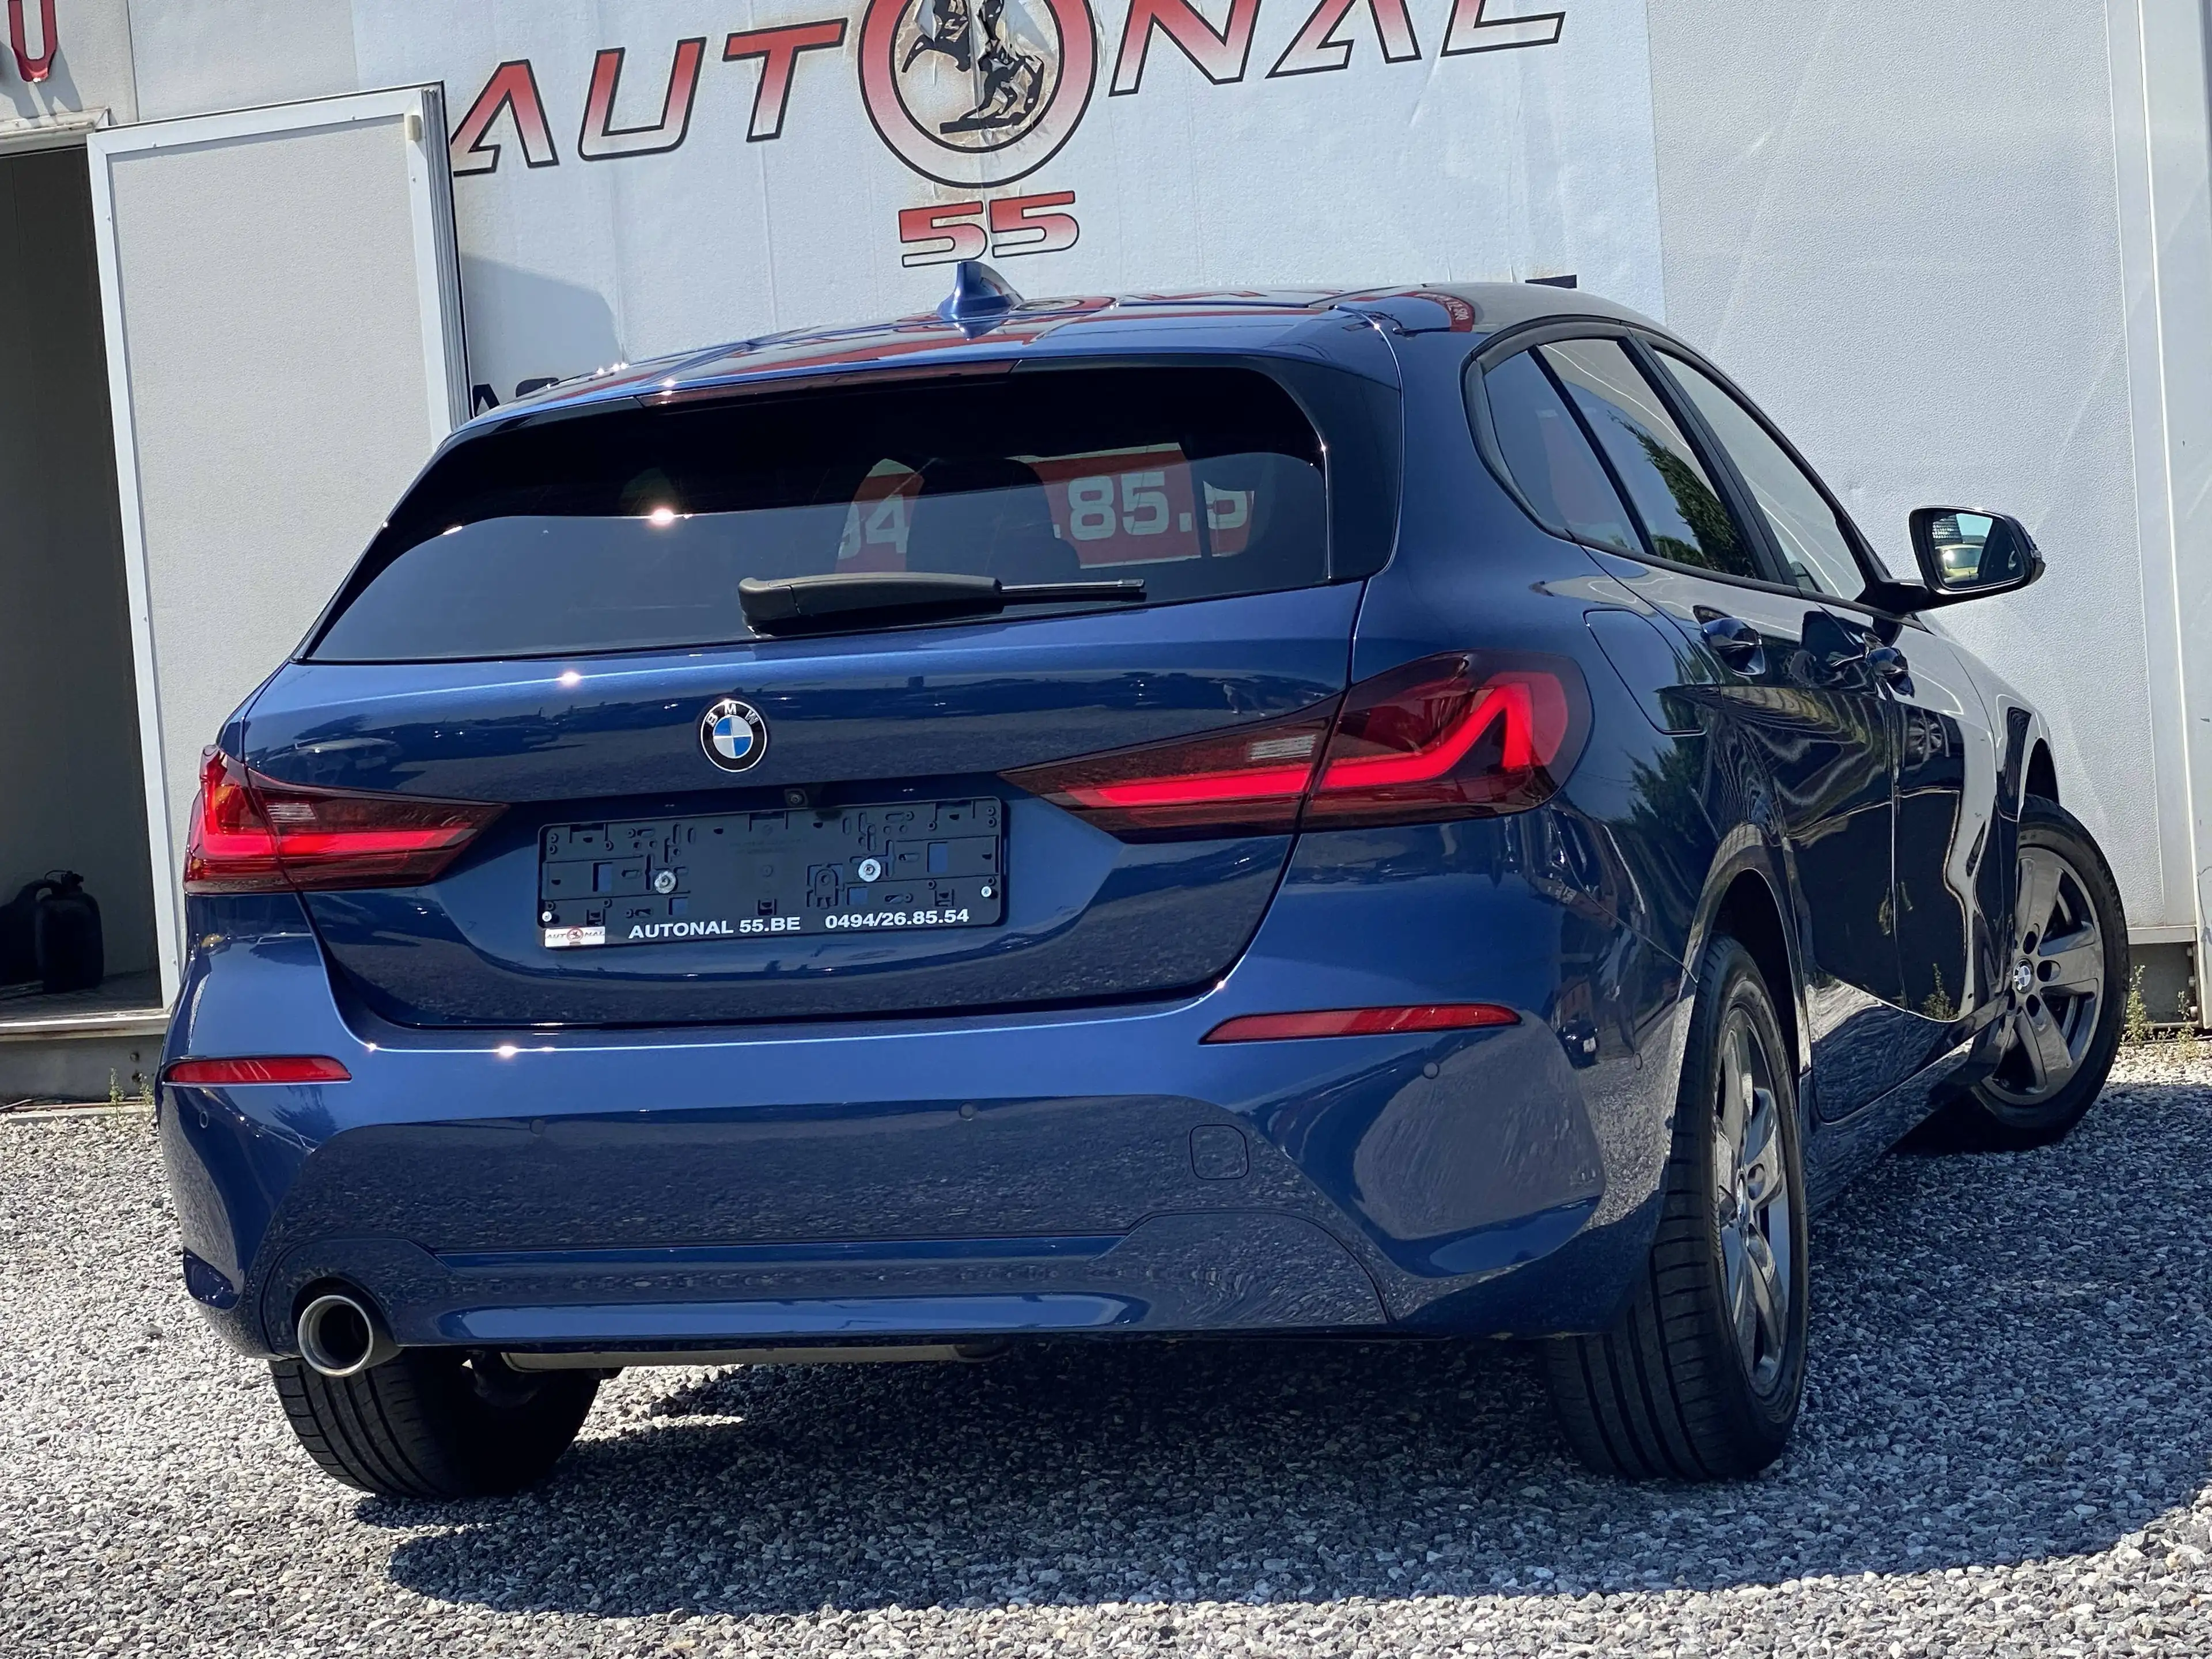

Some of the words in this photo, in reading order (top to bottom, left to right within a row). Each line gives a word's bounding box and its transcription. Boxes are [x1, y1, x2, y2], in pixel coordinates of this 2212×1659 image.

[898, 190, 1080, 268] 55
[706, 703, 759, 728] BMW
[628, 921, 734, 939] AUTONAL
[739, 916, 801, 933] 55.BE
[825, 908, 969, 929] 0494/26.85.54
